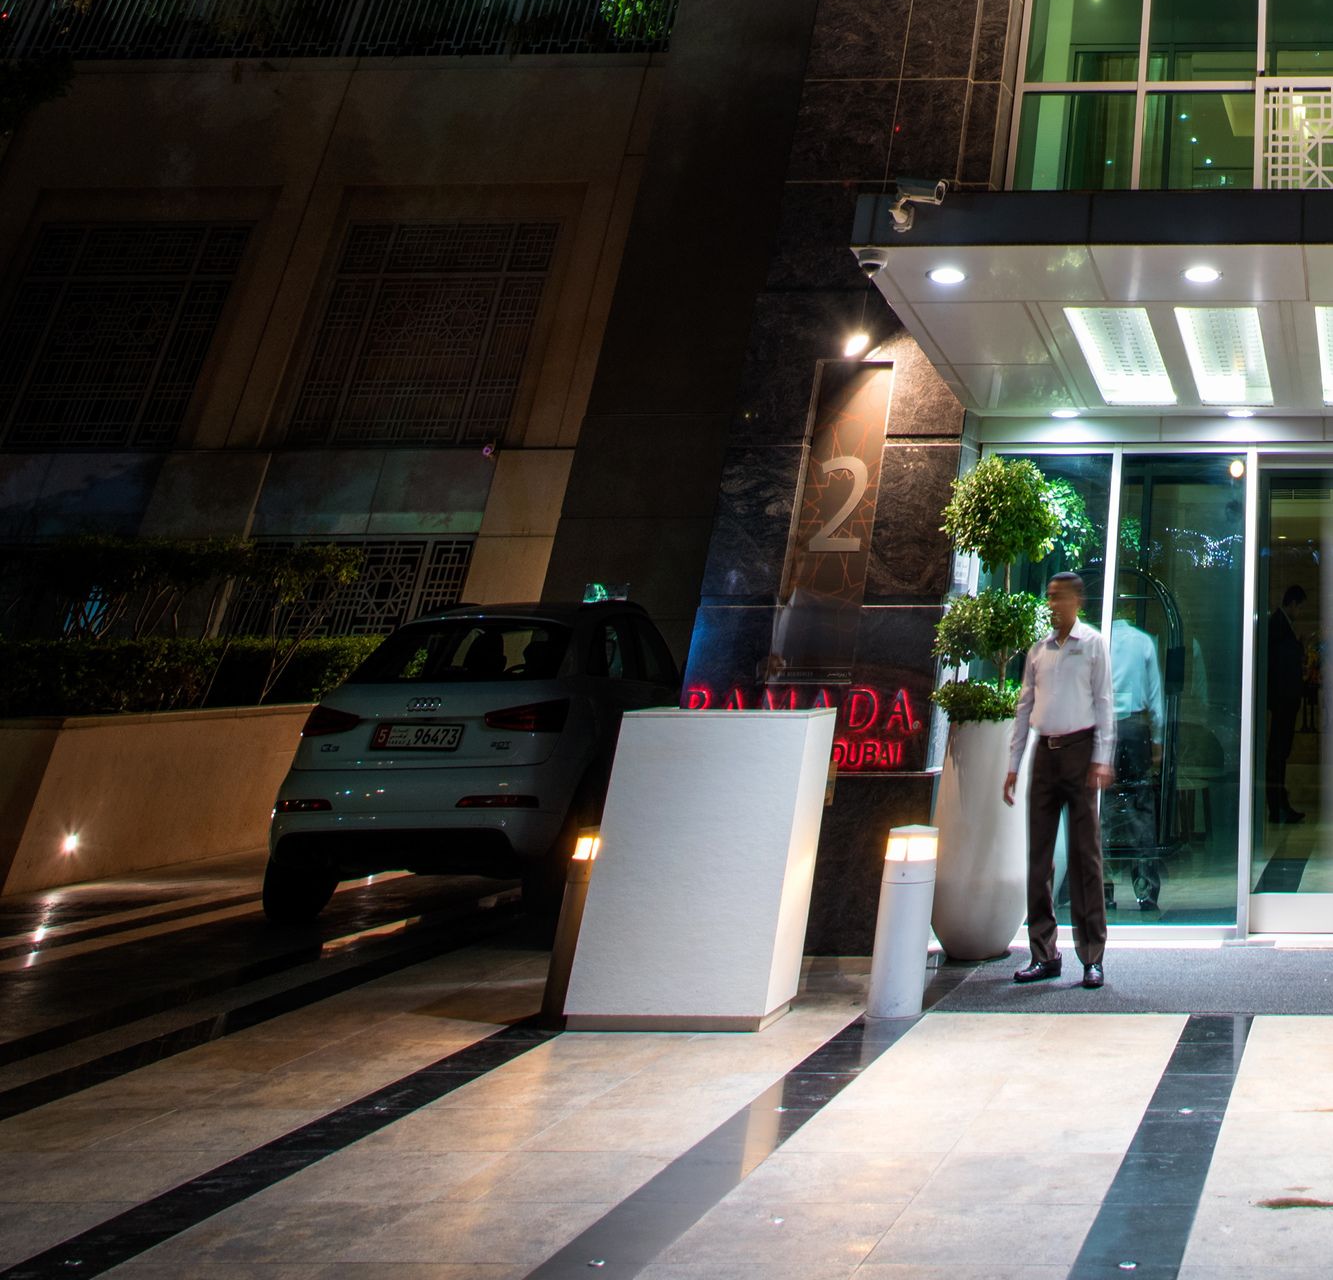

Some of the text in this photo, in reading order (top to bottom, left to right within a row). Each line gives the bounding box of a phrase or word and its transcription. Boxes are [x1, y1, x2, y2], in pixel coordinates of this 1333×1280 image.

[809, 455, 868, 552] 2
[377, 728, 389, 743] 5
[413, 728, 459, 746] 96473
[831, 741, 902, 765] DUBAI
